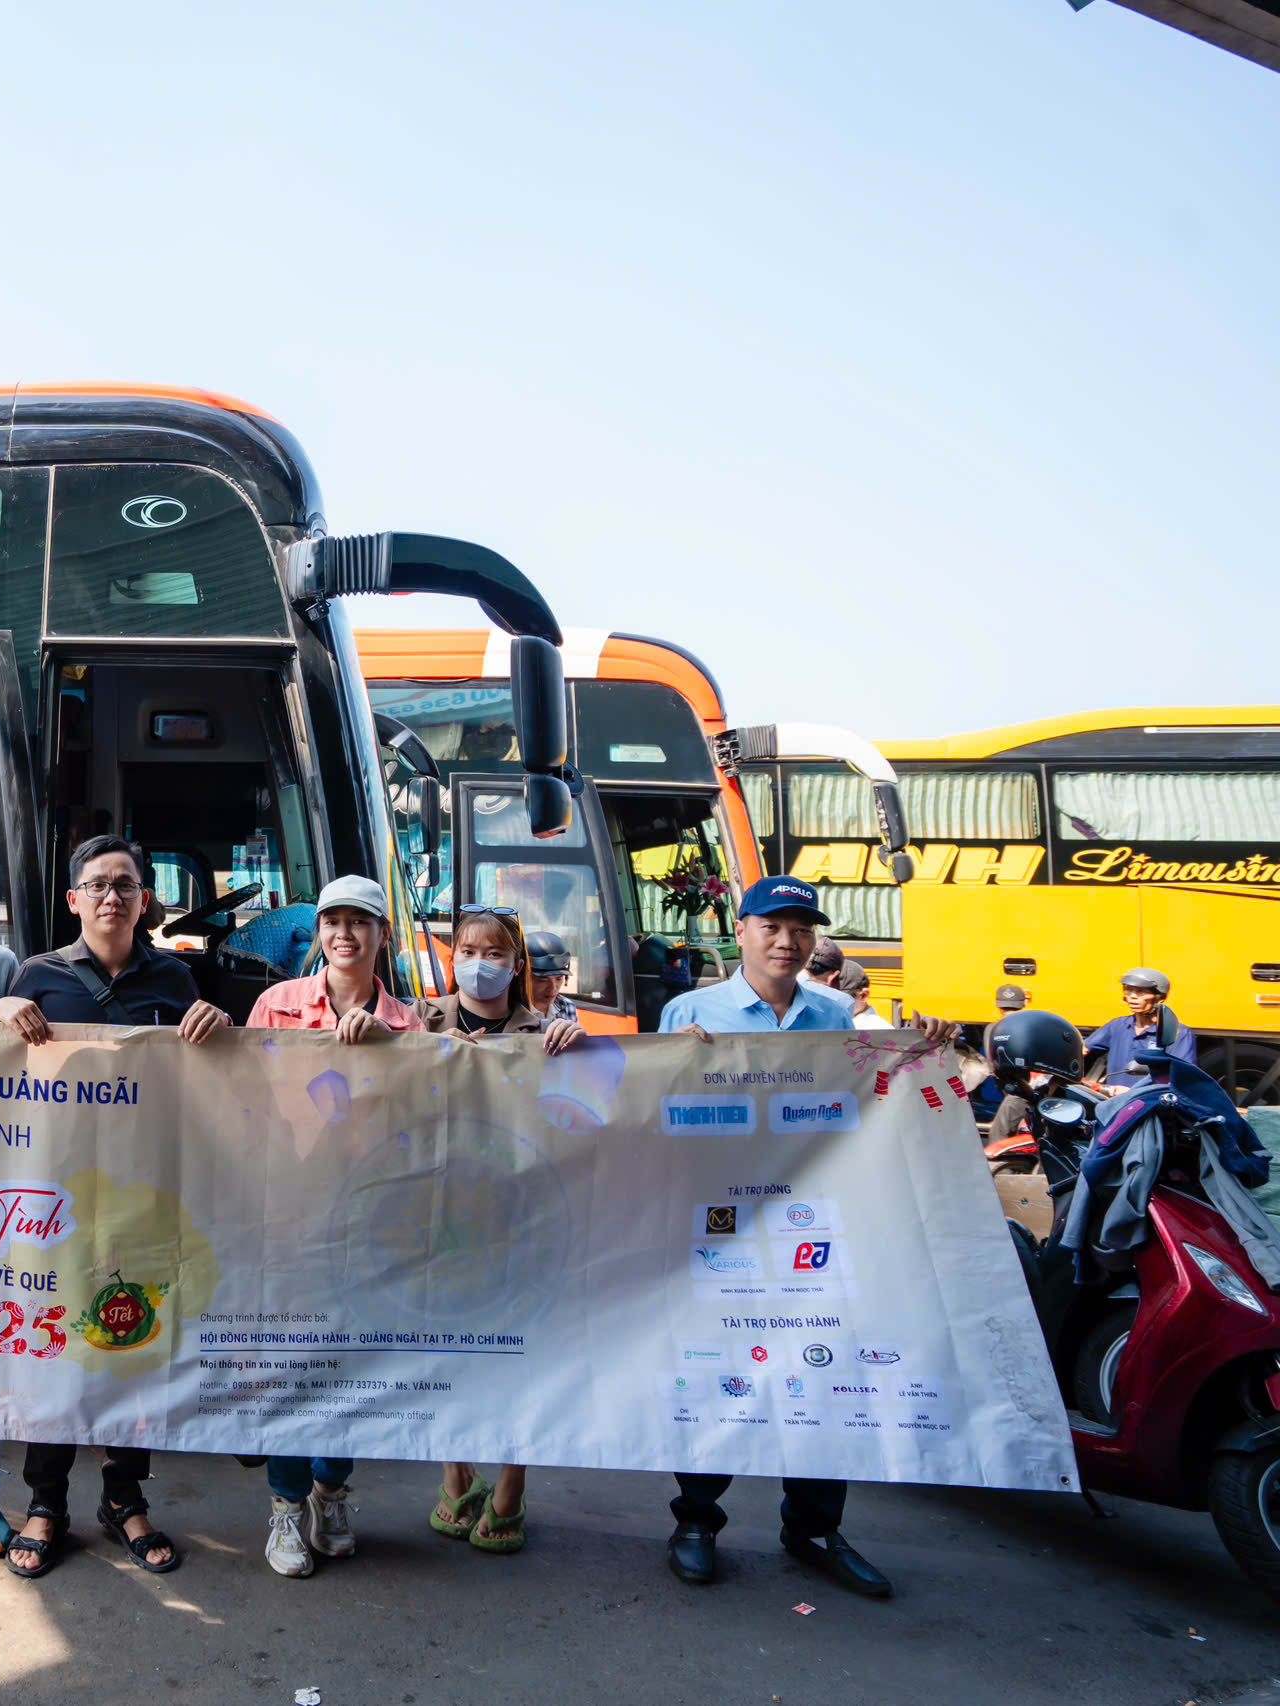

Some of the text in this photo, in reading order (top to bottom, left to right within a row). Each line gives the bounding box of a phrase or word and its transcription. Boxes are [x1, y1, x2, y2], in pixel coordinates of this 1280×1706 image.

[770, 884, 813, 899] APOLLO
[704, 1072, 728, 1084] ĐƠN
[779, 1071, 814, 1084] THÔNG
[77, 1076, 139, 1105] NGÃI
[728, 1185, 742, 1197] TÀI
[745, 1185, 762, 1197] TRỢ
[20, 1268, 58, 1293] QUÊ
[109, 1304, 135, 1324] Tết
[200, 1313, 233, 1325] Chương
[235, 1312, 255, 1323] trình
[257, 1312, 279, 1325] được
[292, 1312, 313, 1323] chức
[315, 1311, 331, 1323] bởi:
[722, 1314, 840, 1332] TÀI TRỢ ĐỒNG HÀNH
[200, 1330, 524, 1346] HỘI ĐỒNG HƯƠNG NGHĨA HÀNH QUẢNG NGÃI TẠI TP. HỒ CHÍ MINH
[200, 1359, 341, 1371] Mọi thông tin xin vui lòng liên hệ:
[232, 1381, 253, 1390] 0905
[254, 1381, 271, 1390] 323
[272, 1381, 288, 1390] 282
[294, 1381, 309, 1390] Ms.
[311, 1380, 327, 1389] MAI
[333, 1380, 354, 1389] 0777
[356, 1380, 388, 1390] 337379
[395, 1381, 411, 1391] Ms.
[432, 1382, 452, 1392] ANH
[198, 1407, 234, 1417] Fanpage:
